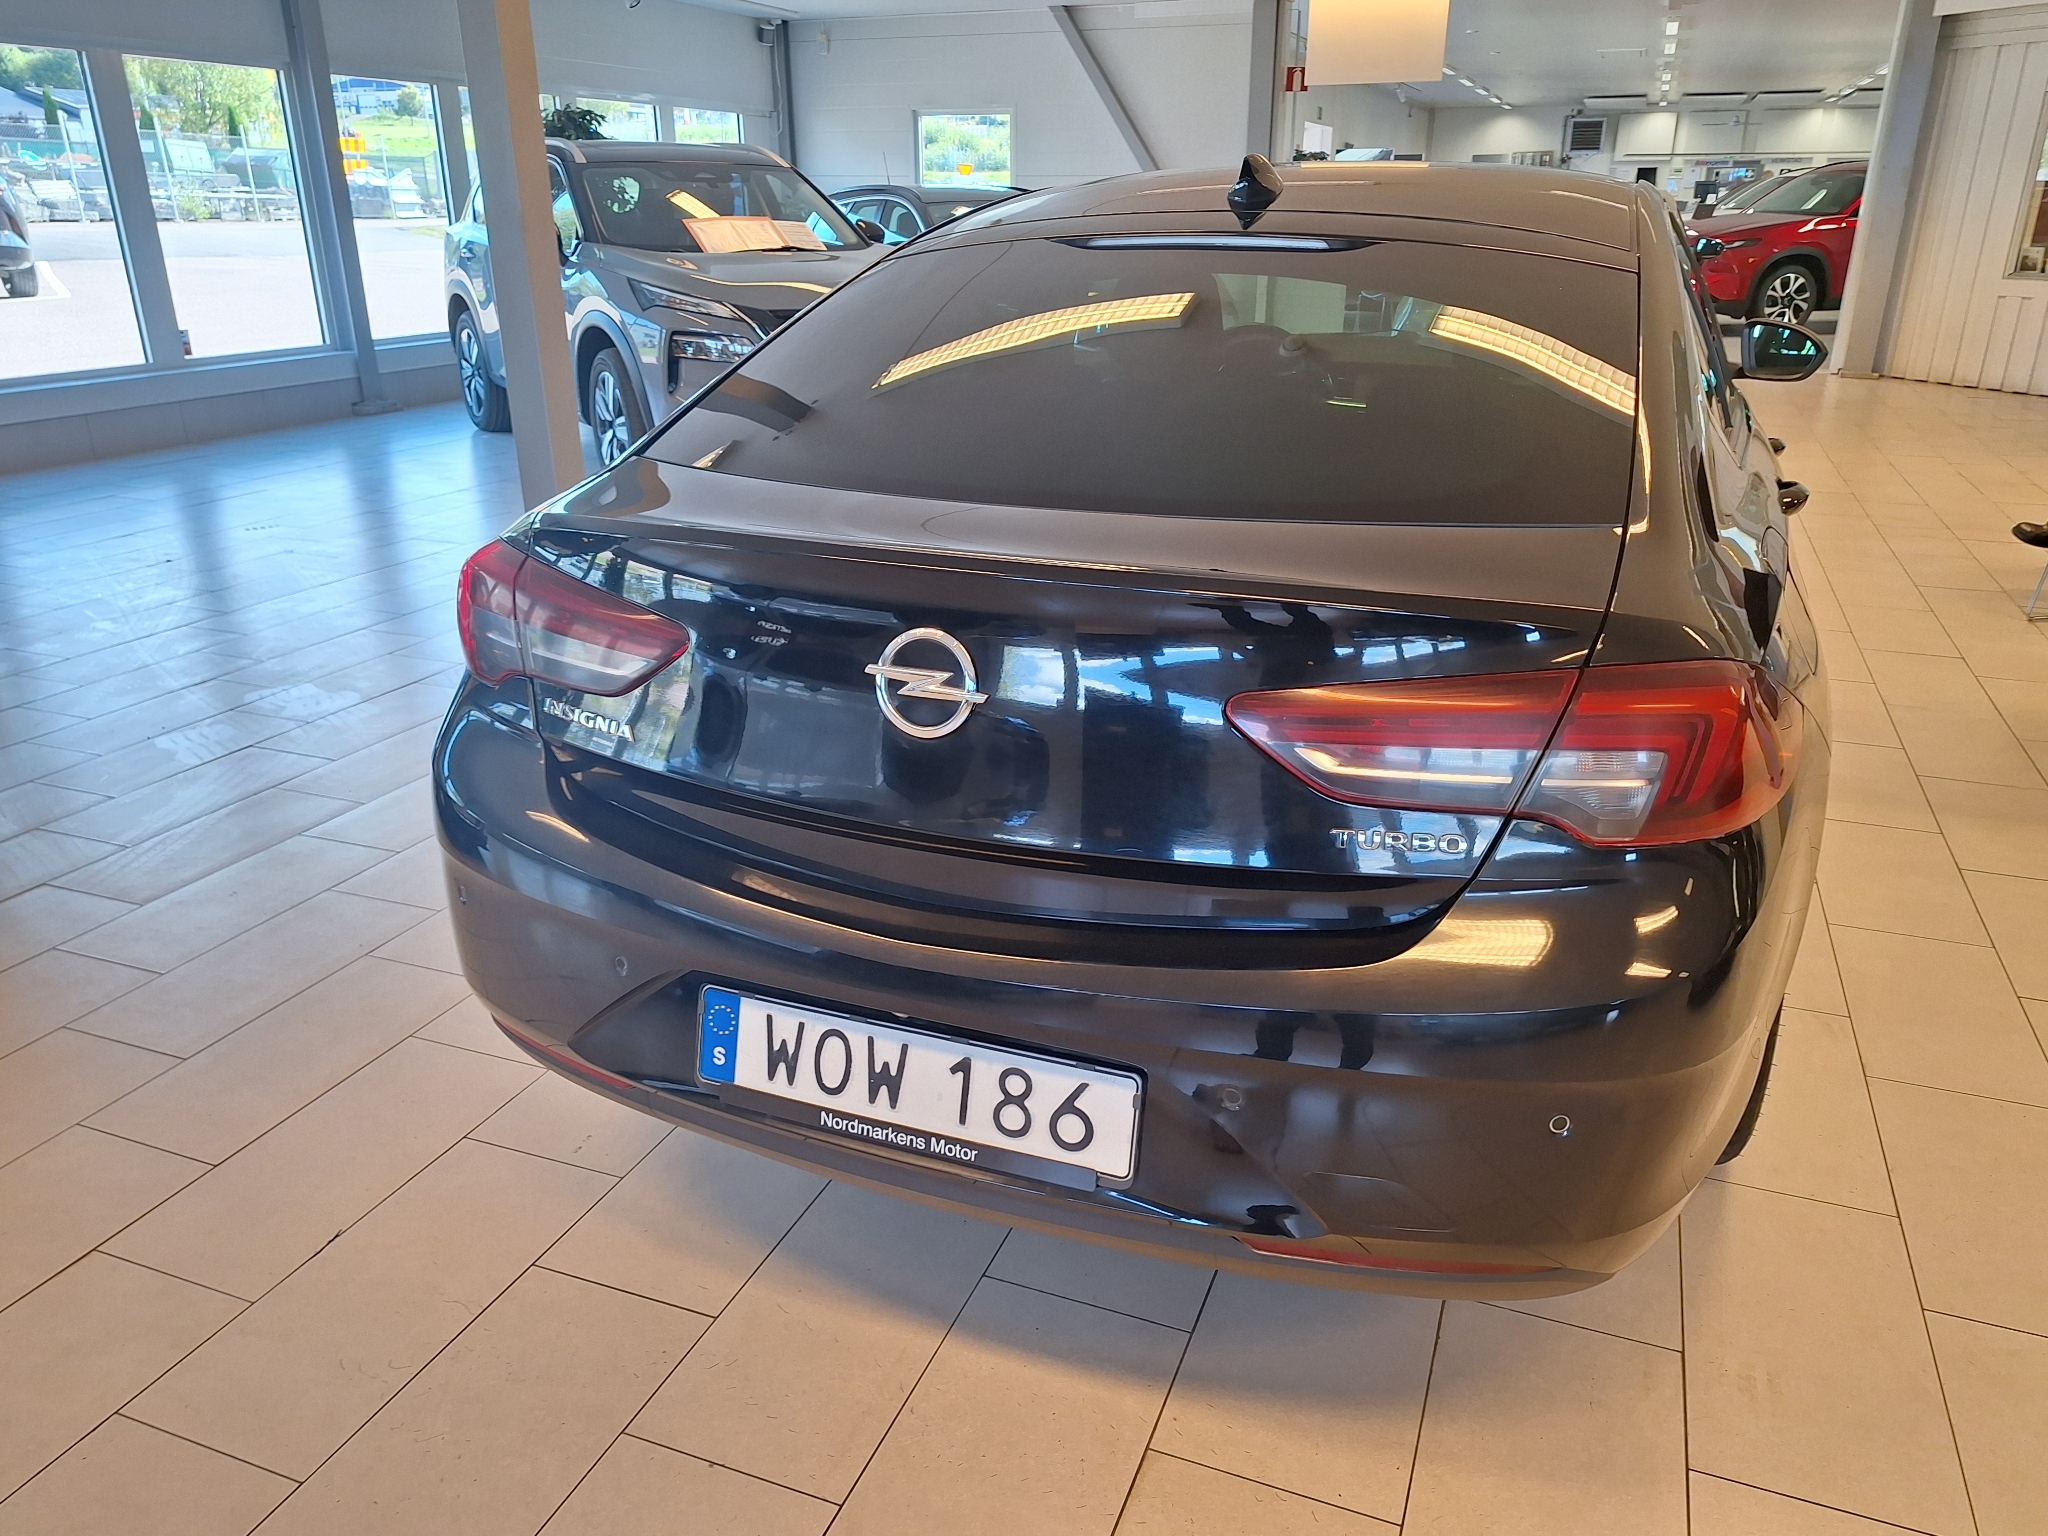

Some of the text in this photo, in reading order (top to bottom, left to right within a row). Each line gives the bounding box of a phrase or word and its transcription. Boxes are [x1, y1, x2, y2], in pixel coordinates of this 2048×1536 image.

[543, 697, 636, 743] INSIGNIA
[1329, 828, 1467, 854] TURBO
[712, 1046, 726, 1066] S
[766, 1013, 1094, 1151] WOW 186
[820, 1110, 978, 1162] Nordmarkens Motor
